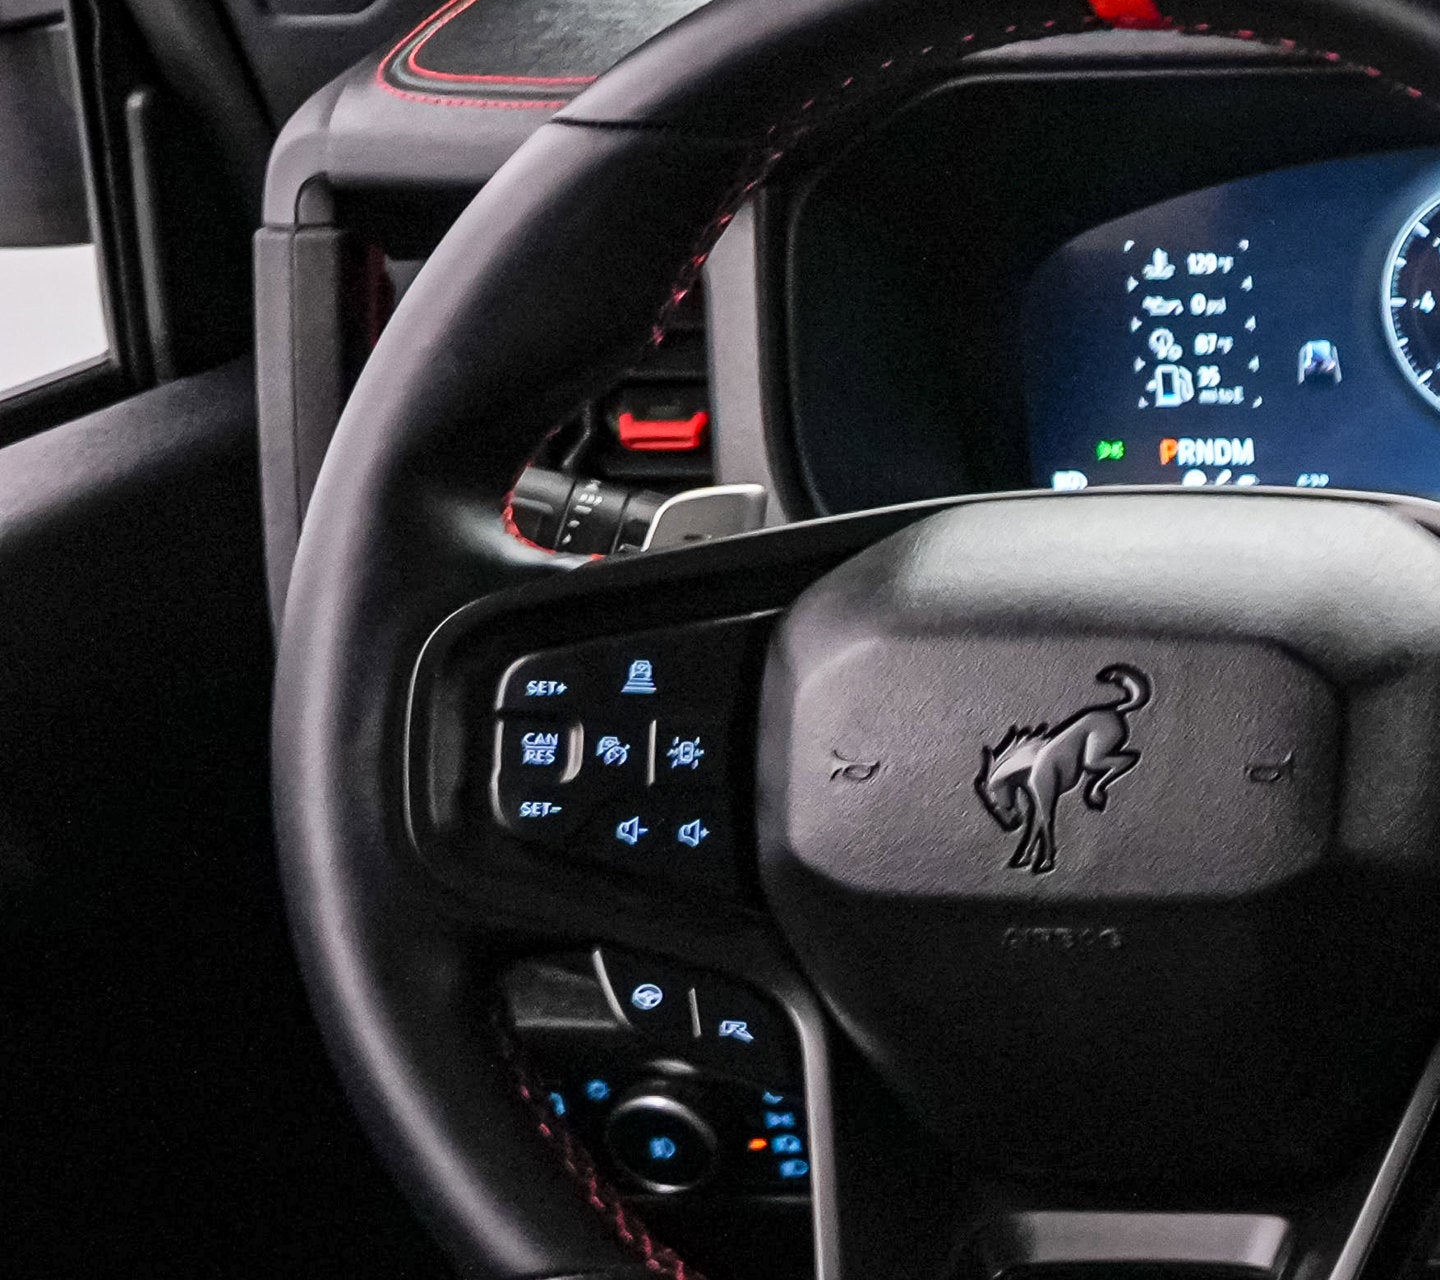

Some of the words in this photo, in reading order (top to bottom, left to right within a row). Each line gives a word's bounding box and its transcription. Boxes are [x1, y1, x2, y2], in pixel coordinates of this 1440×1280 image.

[1418, 290, 1436, 314] 4
[525, 680, 568, 697] SET+
[521, 732, 559, 748] CAN
[521, 748, 556, 766] RES
